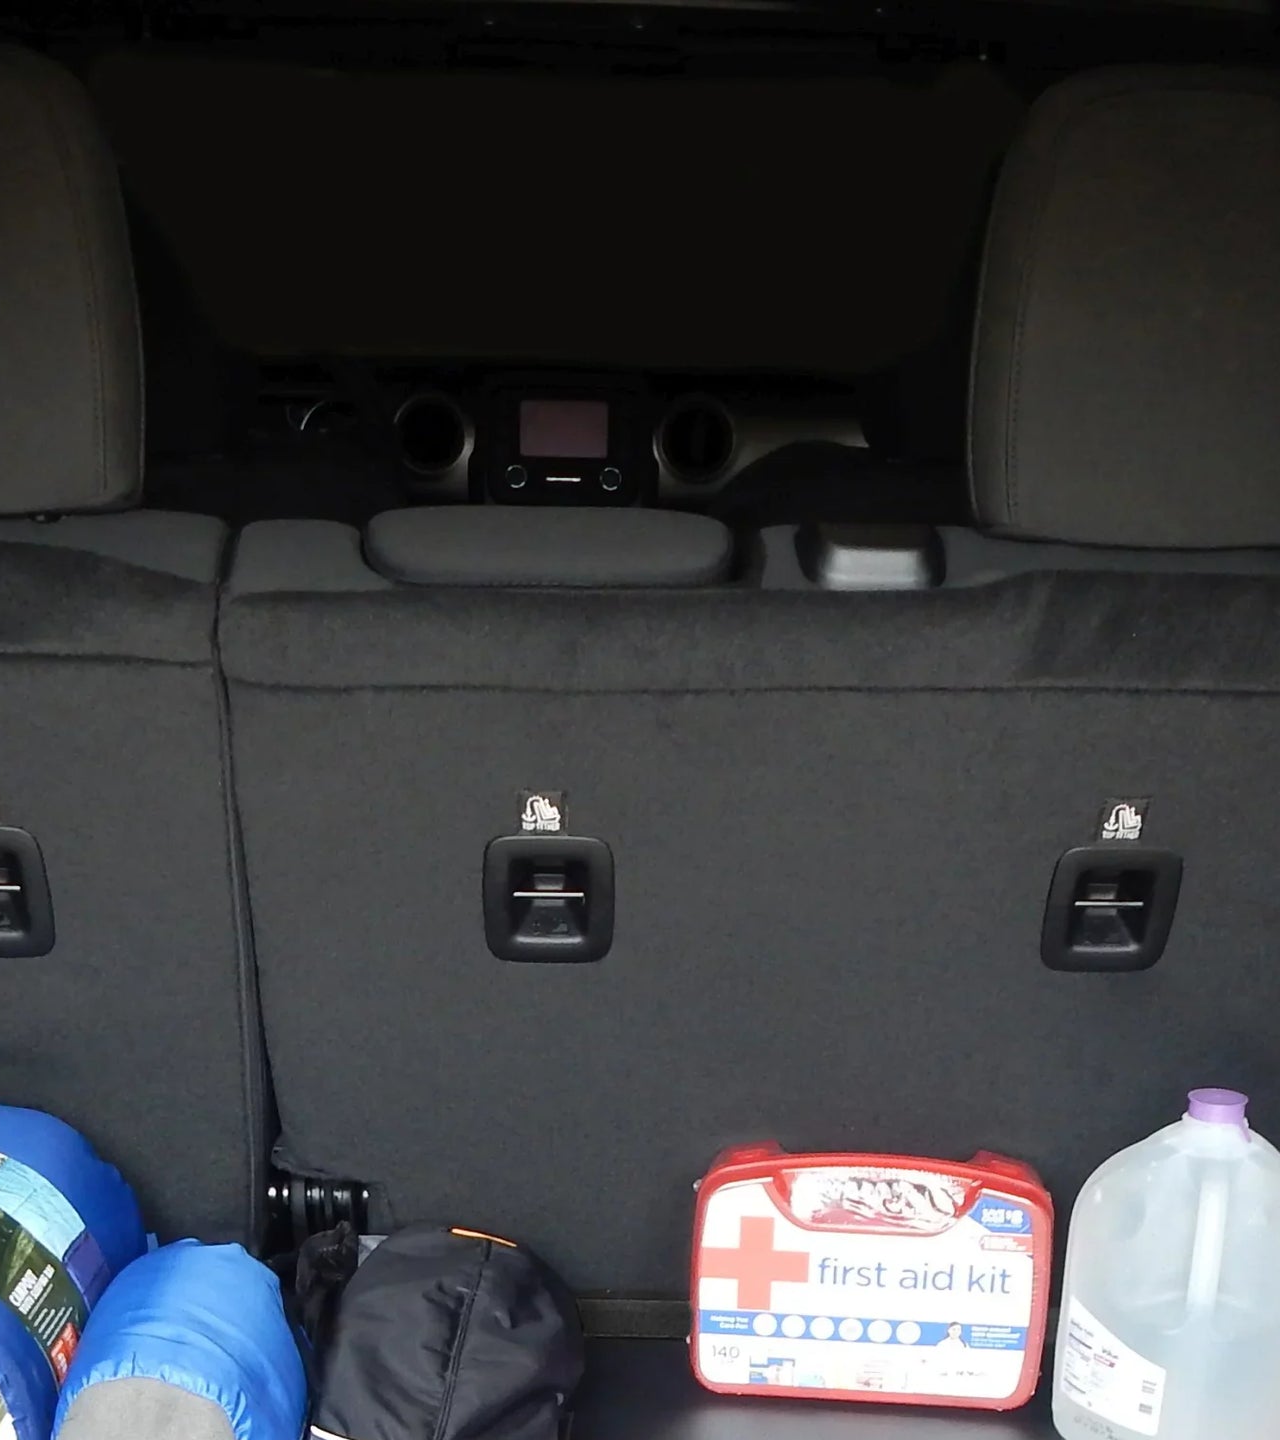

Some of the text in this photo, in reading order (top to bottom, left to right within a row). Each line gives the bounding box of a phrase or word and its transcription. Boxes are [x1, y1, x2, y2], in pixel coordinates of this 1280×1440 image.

[818, 1256, 1012, 1295] first aid kit
[712, 1344, 740, 1359] 140
